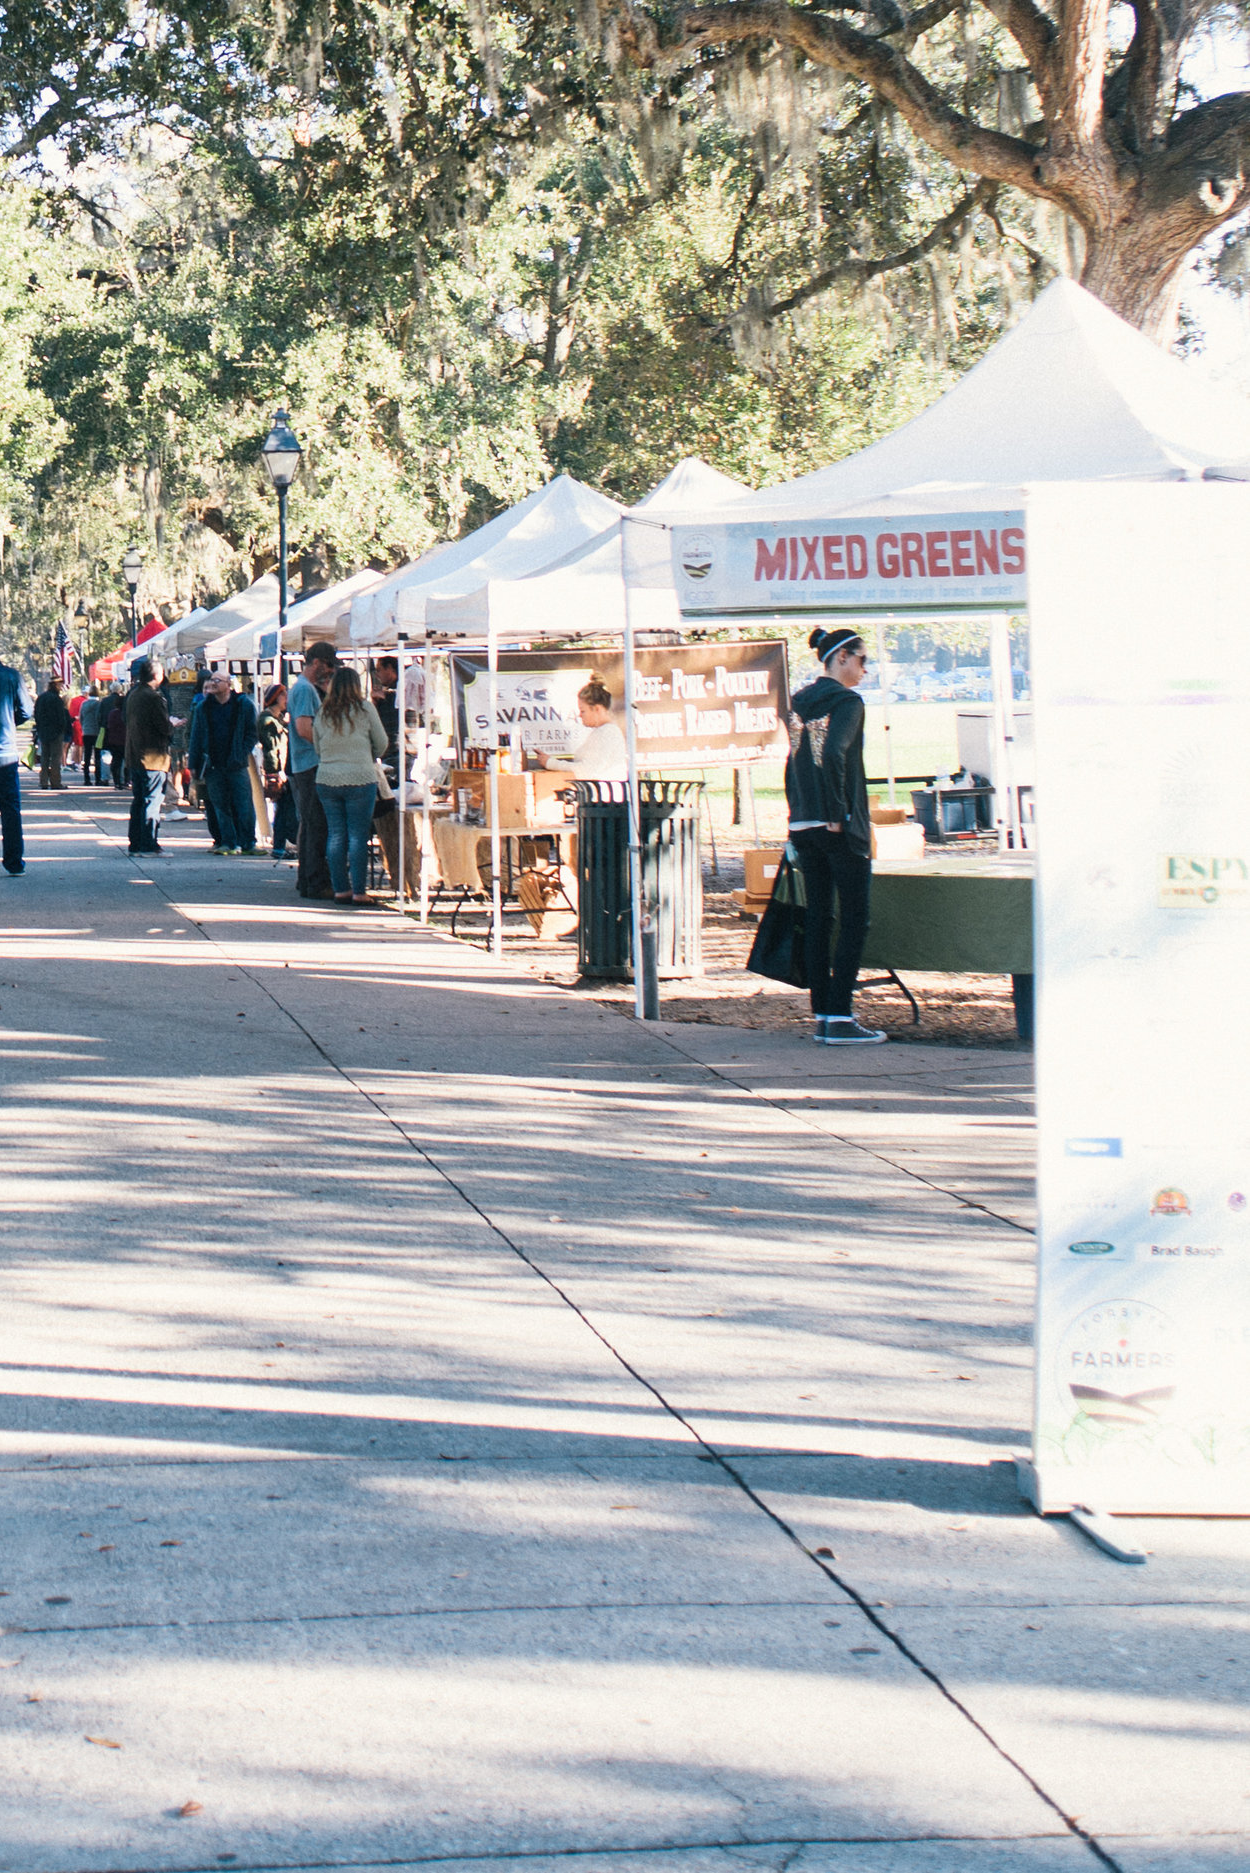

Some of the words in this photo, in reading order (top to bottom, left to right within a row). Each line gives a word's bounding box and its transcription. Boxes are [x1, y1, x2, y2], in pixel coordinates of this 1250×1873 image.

[754, 535, 868, 581] MIXED
[876, 528, 1025, 579] GREENS
[1166, 856, 1248, 880] ESPY
[1151, 1245, 1180, 1256] Brad
[1184, 1245, 1224, 1259] Baugh
[1071, 1351, 1176, 1368] FARMERS
